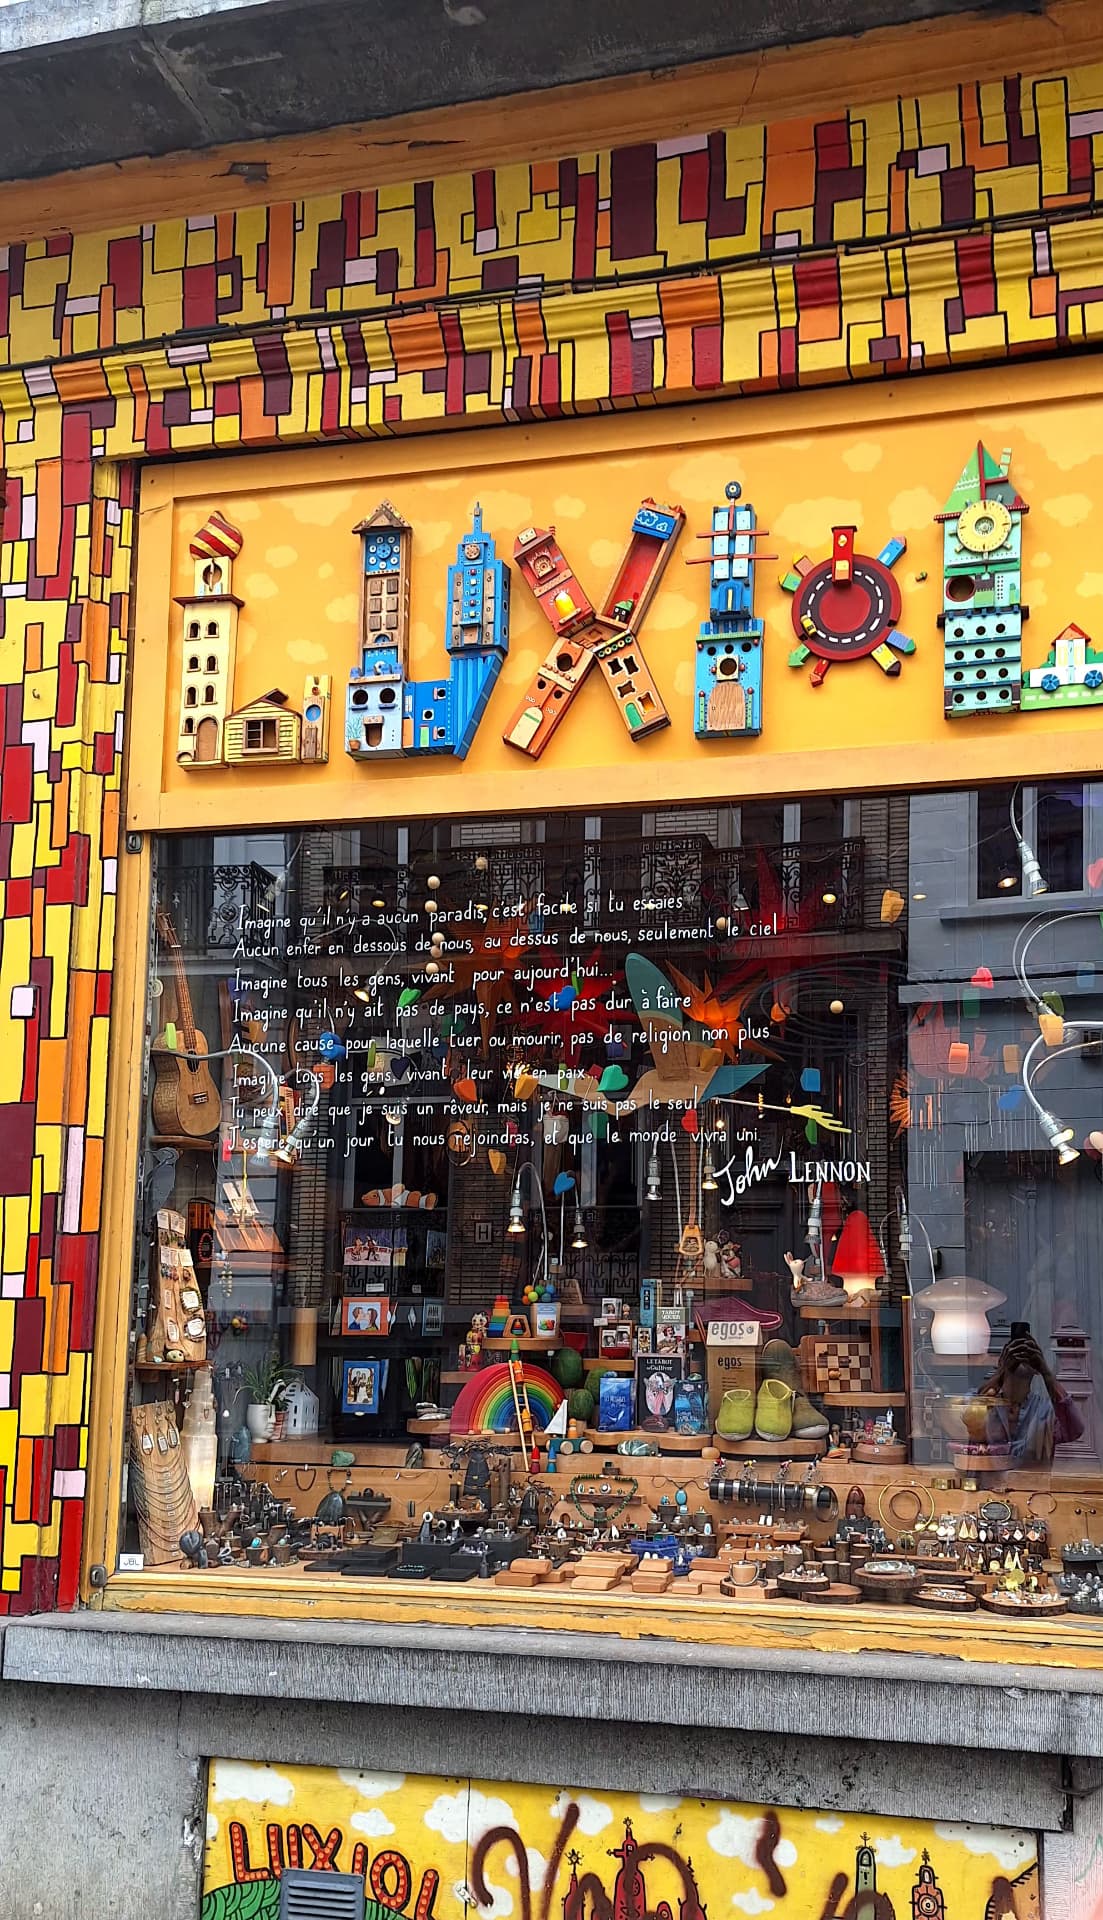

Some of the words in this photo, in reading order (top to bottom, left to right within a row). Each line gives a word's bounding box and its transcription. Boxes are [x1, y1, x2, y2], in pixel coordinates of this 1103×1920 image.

[232, 943, 279, 958] Aucun
[287, 938, 320, 955] enfer
[328, 944, 344, 954] en
[354, 935, 406, 953] dessous
[415, 933, 431, 951] de
[440, 939, 474, 953] nous,
[484, 937, 501, 949] au
[509, 926, 558, 946] dessus
[569, 926, 586, 944] de
[594, 931, 631, 944] nous,
[638, 917, 714, 940] seulement
[727, 918, 739, 937] le
[749, 912, 777, 935] ciel
[236, 905, 291, 939] Imagine
[300, 909, 330, 932] qu'il
[336, 909, 356, 934] n'y
[362, 914, 370, 926] a
[377, 912, 418, 925] aucun
[429, 901, 487, 931] paradis,
[492, 901, 525, 918] c'est
[537, 894, 577, 916] facile
[587, 897, 600, 912] si
[608, 890, 624, 912] tu
[633, 895, 682, 910] essaies
[234, 967, 287, 998] Imagine
[297, 969, 327, 988] tous
[339, 967, 359, 986] les
[368, 973, 404, 996] gens,
[412, 963, 455, 983] vivant
[473, 970, 504, 990] pour
[514, 957, 613, 991] aujourd'hui...
[232, 998, 288, 1031] Imagine
[296, 1000, 327, 1024] qu'il
[336, 1001, 355, 1027] n'y
[364, 996, 384, 1018] ait
[396, 1005, 418, 1026] pas
[429, 1000, 445, 1016] de
[454, 1003, 489, 1024] pays,
[497, 1002, 512, 1014] ce
[520, 992, 560, 1014] n'est
[571, 998, 595, 1021] pas
[606, 992, 631, 1011] dur
[642, 988, 649, 1009] à
[656, 986, 691, 1008] faire
[228, 1034, 286, 1053] Aucune
[294, 1038, 334, 1051] cause
[346, 1039, 375, 1059] pour
[386, 1028, 440, 1057] laquelle
[450, 1029, 481, 1048] tuer
[489, 1036, 506, 1047] ou
[513, 1032, 564, 1048] mourir,
[571, 1034, 593, 1055] pas
[604, 1024, 622, 1044] de
[632, 1022, 690, 1053] religion
[702, 1028, 728, 1040] non
[738, 1018, 770, 1049] plus
[296, 1062, 323, 1083] tous
[335, 1063, 353, 1082] les
[407, 1058, 447, 1082] vivant
[466, 1059, 493, 1081] leur
[532, 1068, 547, 1078] en
[229, 1097, 244, 1120] Tu
[253, 1105, 283, 1122] peux
[294, 1099, 318, 1116] dire
[328, 1104, 351, 1123] que
[359, 1102, 372, 1125] je
[382, 1102, 408, 1115] suis
[417, 1104, 434, 1115] un
[443, 1100, 488, 1116] rêveur,
[497, 1102, 527, 1113] mais
[538, 1102, 550, 1121] je
[558, 1100, 573, 1111] ne
[583, 1097, 607, 1110] suis
[616, 1099, 636, 1119] pas
[649, 1090, 660, 1110] le
[668, 1086, 698, 1110] seul
[296, 1130, 334, 1157] qu'un
[344, 1134, 374, 1156] jour
[388, 1128, 403, 1146] tu
[413, 1135, 444, 1146] nous
[455, 1126, 534, 1156] rejoindras,
[544, 1123, 558, 1144] et
[569, 1131, 593, 1155] que
[607, 1123, 621, 1142] le
[630, 1120, 676, 1142] monde
[692, 1130, 726, 1142] vivra
[736, 1130, 760, 1142] uni.
[712, 1136, 784, 1206] John
[712, 1322, 744, 1340] egos
[718, 1357, 742, 1370] egos
